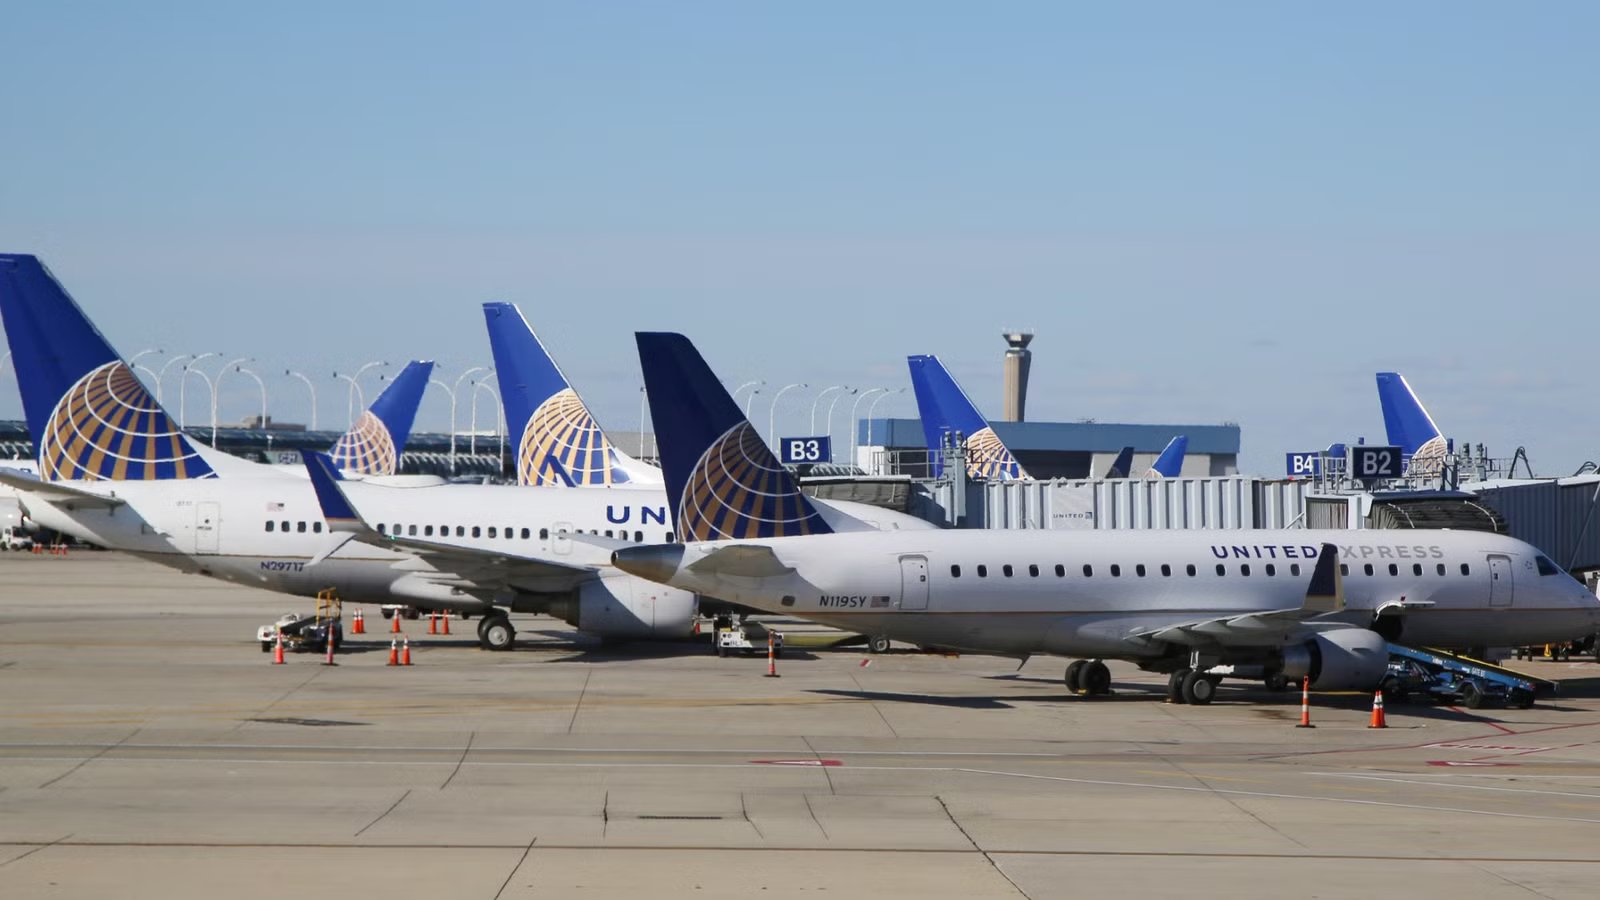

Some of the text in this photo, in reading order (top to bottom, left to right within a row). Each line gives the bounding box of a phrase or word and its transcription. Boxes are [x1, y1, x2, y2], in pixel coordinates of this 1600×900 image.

[790, 439, 820, 461] B3
[1293, 455, 1313, 473] B4
[1362, 451, 1392, 475] B2
[606, 504, 665, 525] UN
[1210, 545, 1445, 559] UNITED XPRESS
[260, 561, 305, 572] N29717
[819, 595, 867, 608] N119SY
